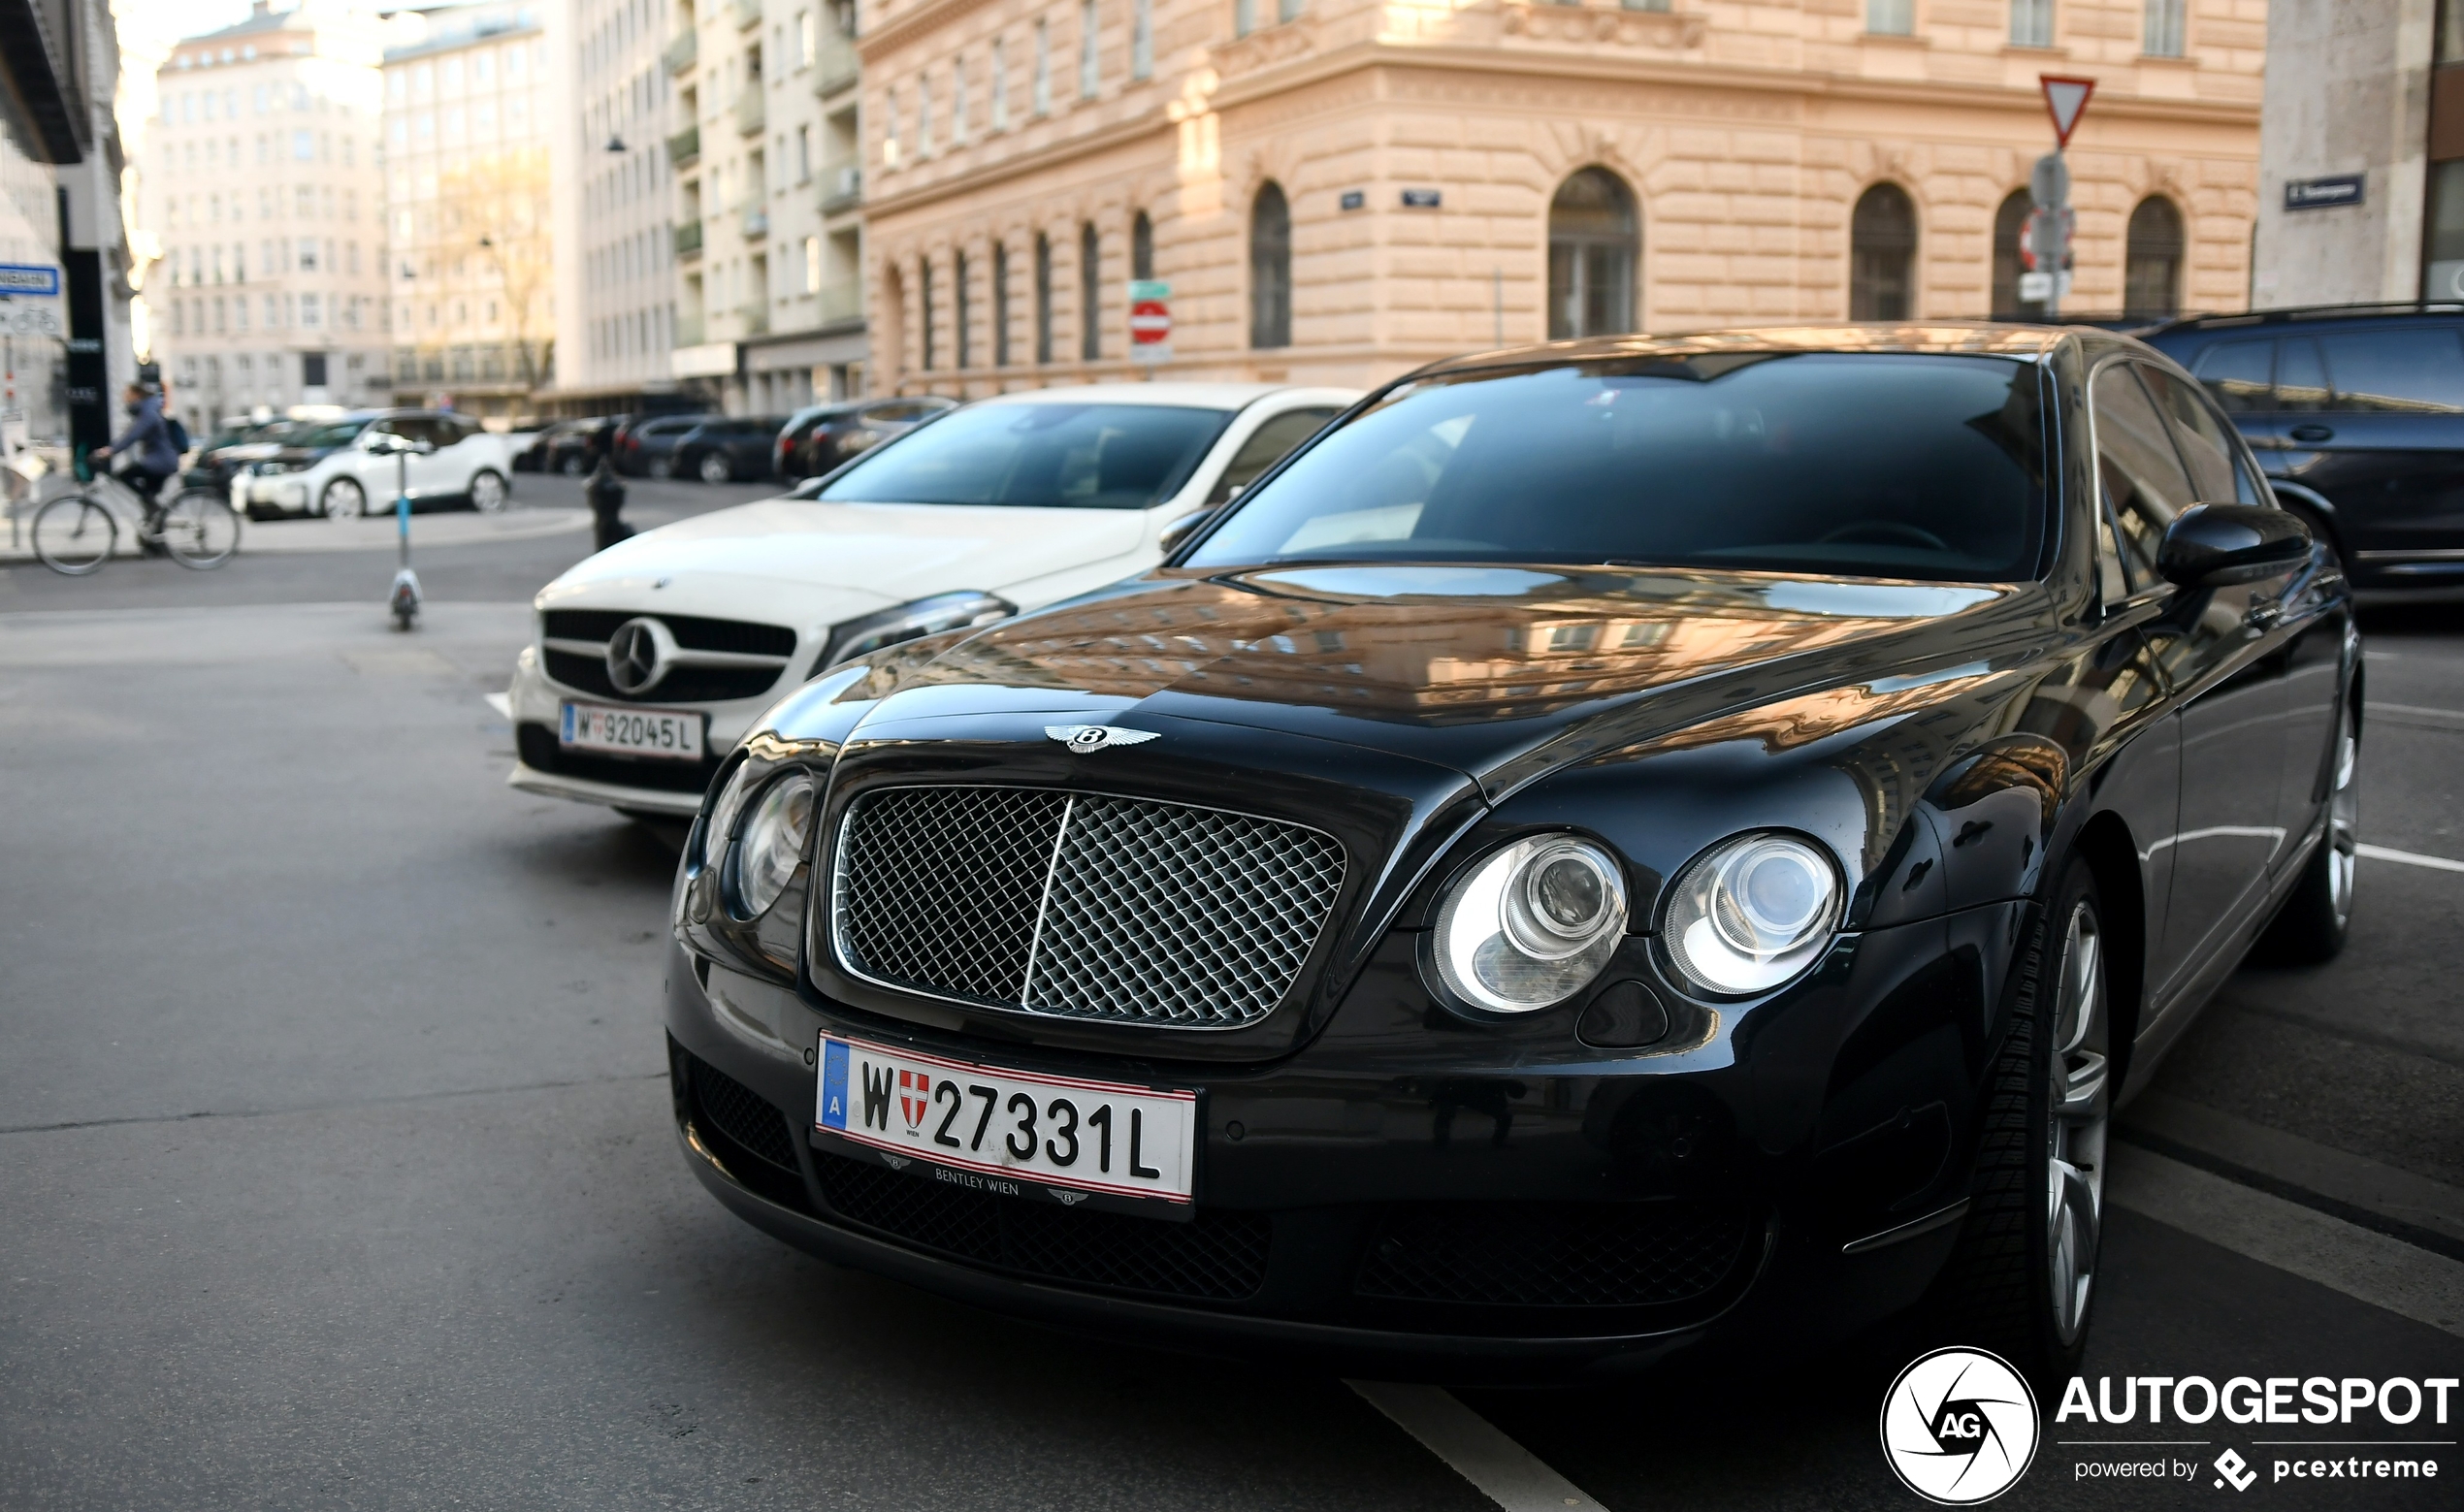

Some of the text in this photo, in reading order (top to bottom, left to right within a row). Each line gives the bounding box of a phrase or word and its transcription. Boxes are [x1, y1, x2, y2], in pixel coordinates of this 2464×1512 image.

[578, 712, 691, 751] W 92045L
[1077, 728, 1103, 743] B
[828, 1100, 841, 1116] A
[863, 1062, 1162, 1179] W 27331L
[906, 1129, 920, 1139] WIEN
[935, 1168, 1019, 1196] BENTLEY WIEN
